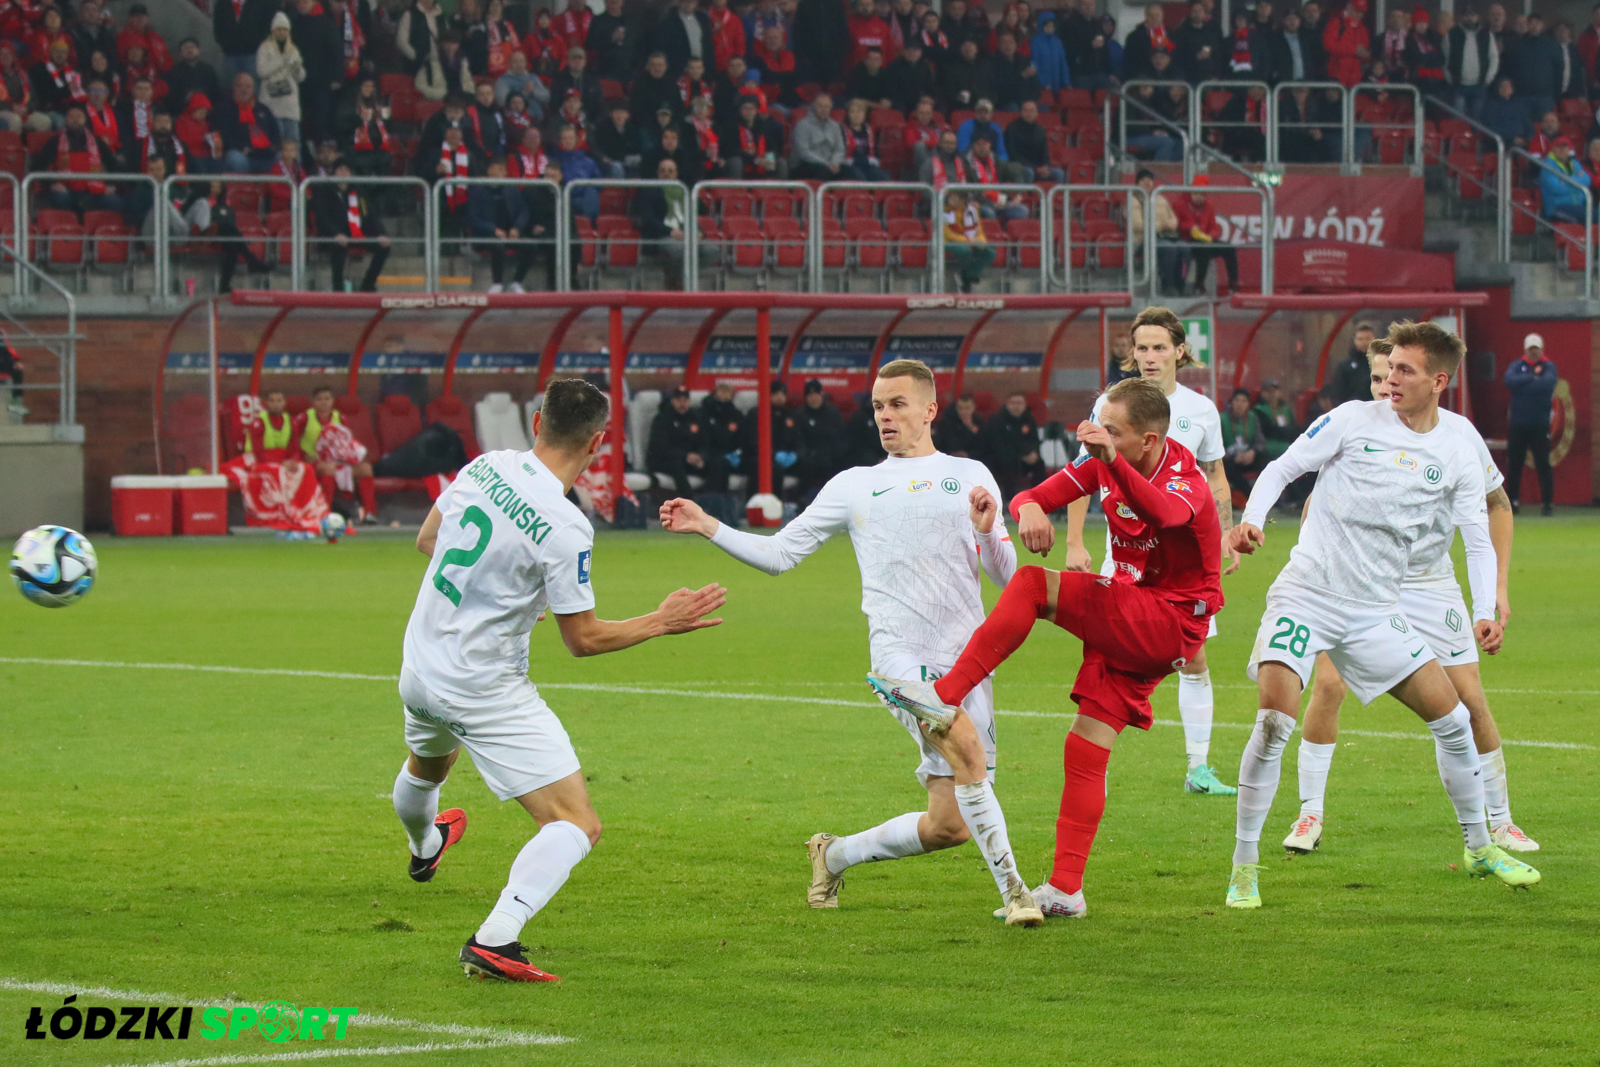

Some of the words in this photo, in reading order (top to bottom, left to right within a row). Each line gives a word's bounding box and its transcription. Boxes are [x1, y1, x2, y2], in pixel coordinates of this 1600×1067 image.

[466, 457, 553, 546] BARTKOWSKI
[432, 504, 493, 608] 2
[1268, 616, 1311, 659] 28
